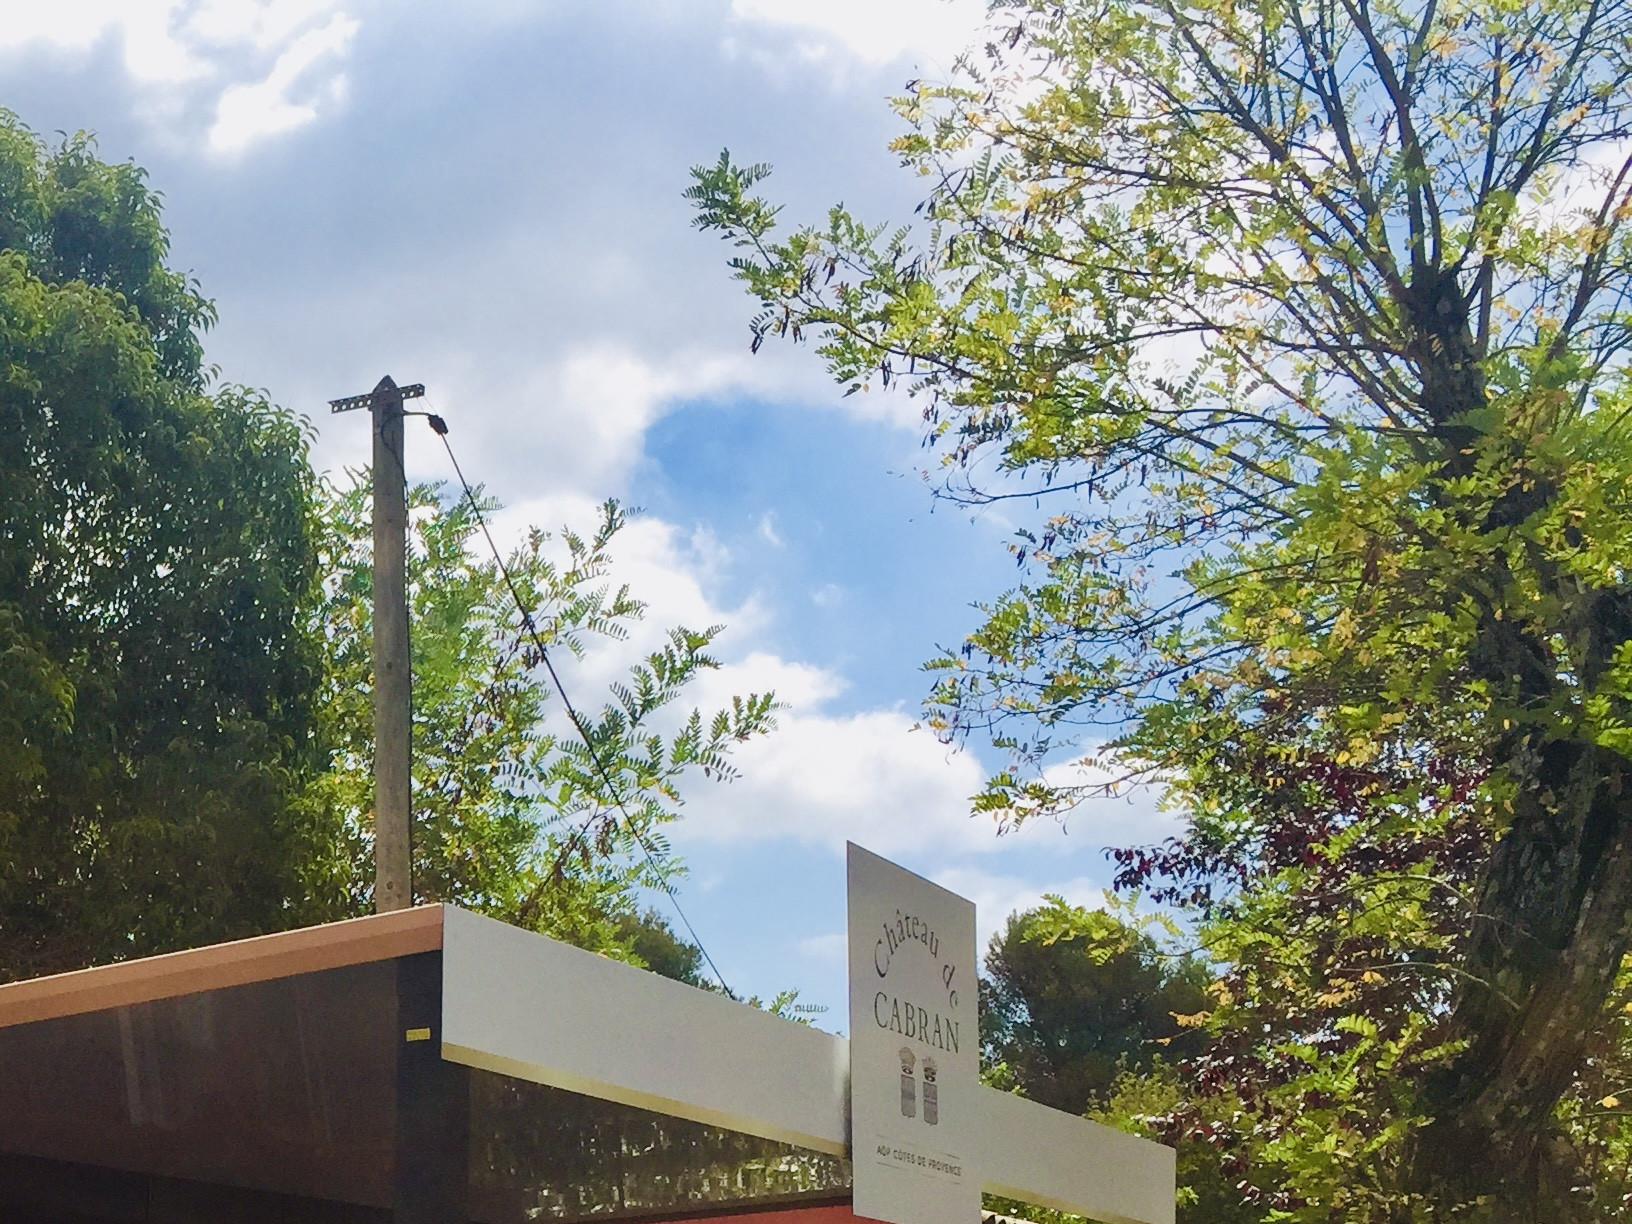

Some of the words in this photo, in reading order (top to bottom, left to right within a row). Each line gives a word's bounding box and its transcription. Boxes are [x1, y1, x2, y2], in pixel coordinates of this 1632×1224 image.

[874, 909, 939, 978] Château
[942, 964, 958, 1008] de
[874, 991, 959, 1053] CABRAN
[877, 1145, 890, 1156] AOP
[928, 1159, 961, 1176] PROVENCE
